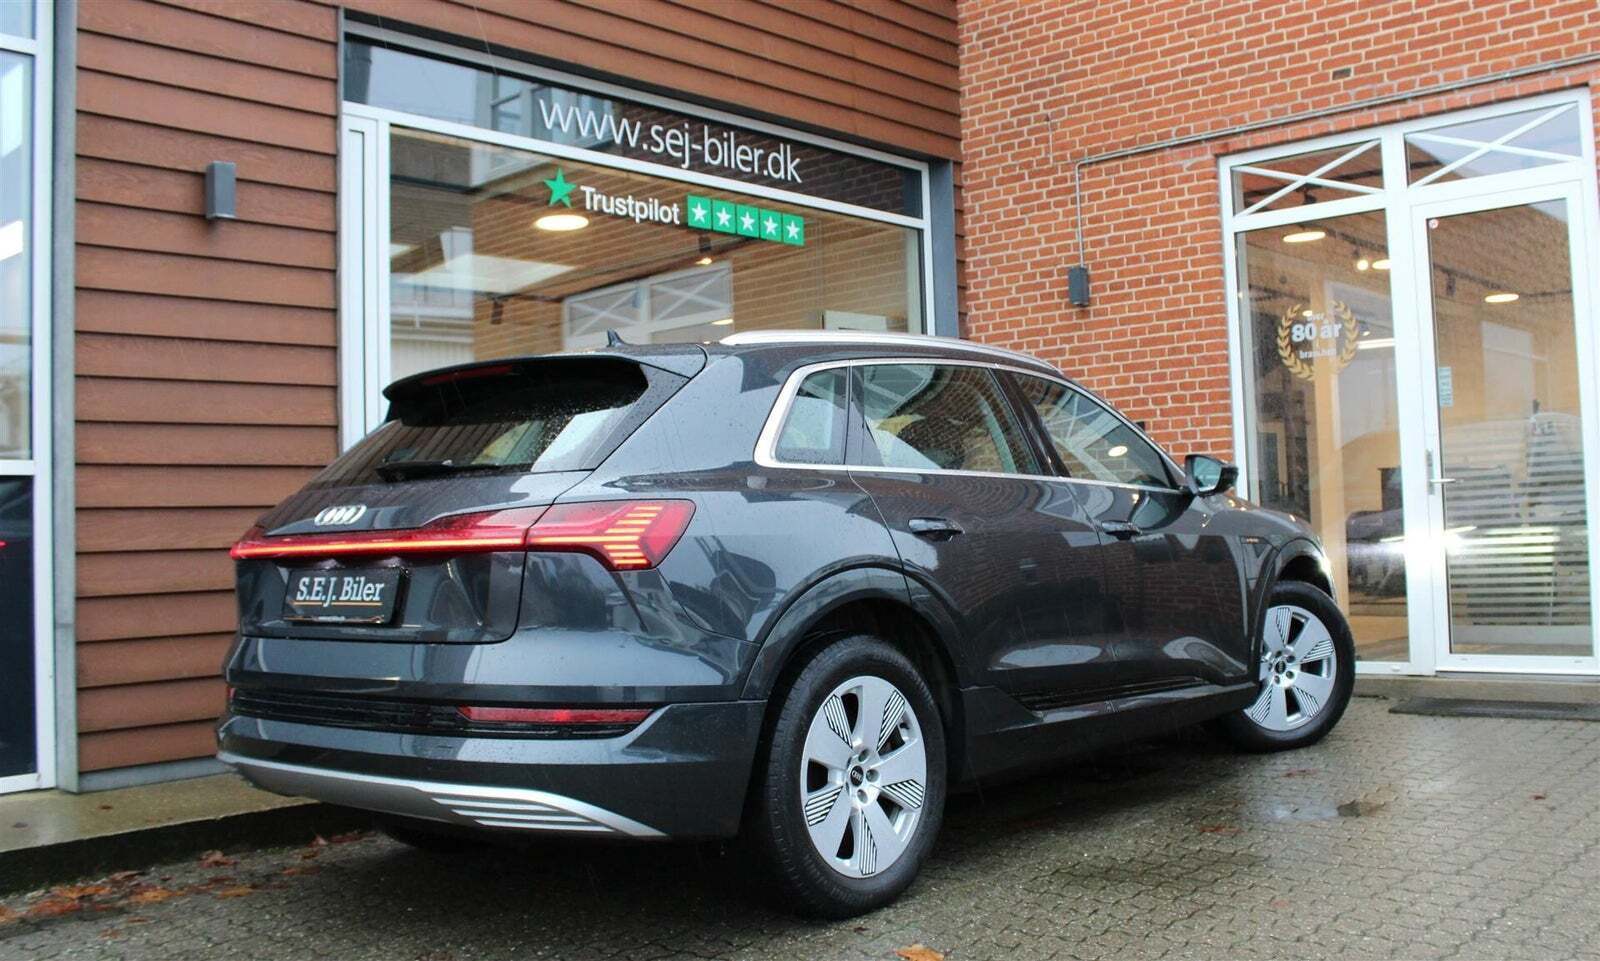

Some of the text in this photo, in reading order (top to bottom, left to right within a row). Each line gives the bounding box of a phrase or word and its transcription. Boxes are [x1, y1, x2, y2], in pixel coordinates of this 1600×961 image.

[539, 99, 802, 183] www.sej-biler.dk
[580, 185, 680, 225] Trustpilot
[1291, 323, 1316, 342] 80
[296, 576, 385, 607] S.E.J. Biler
